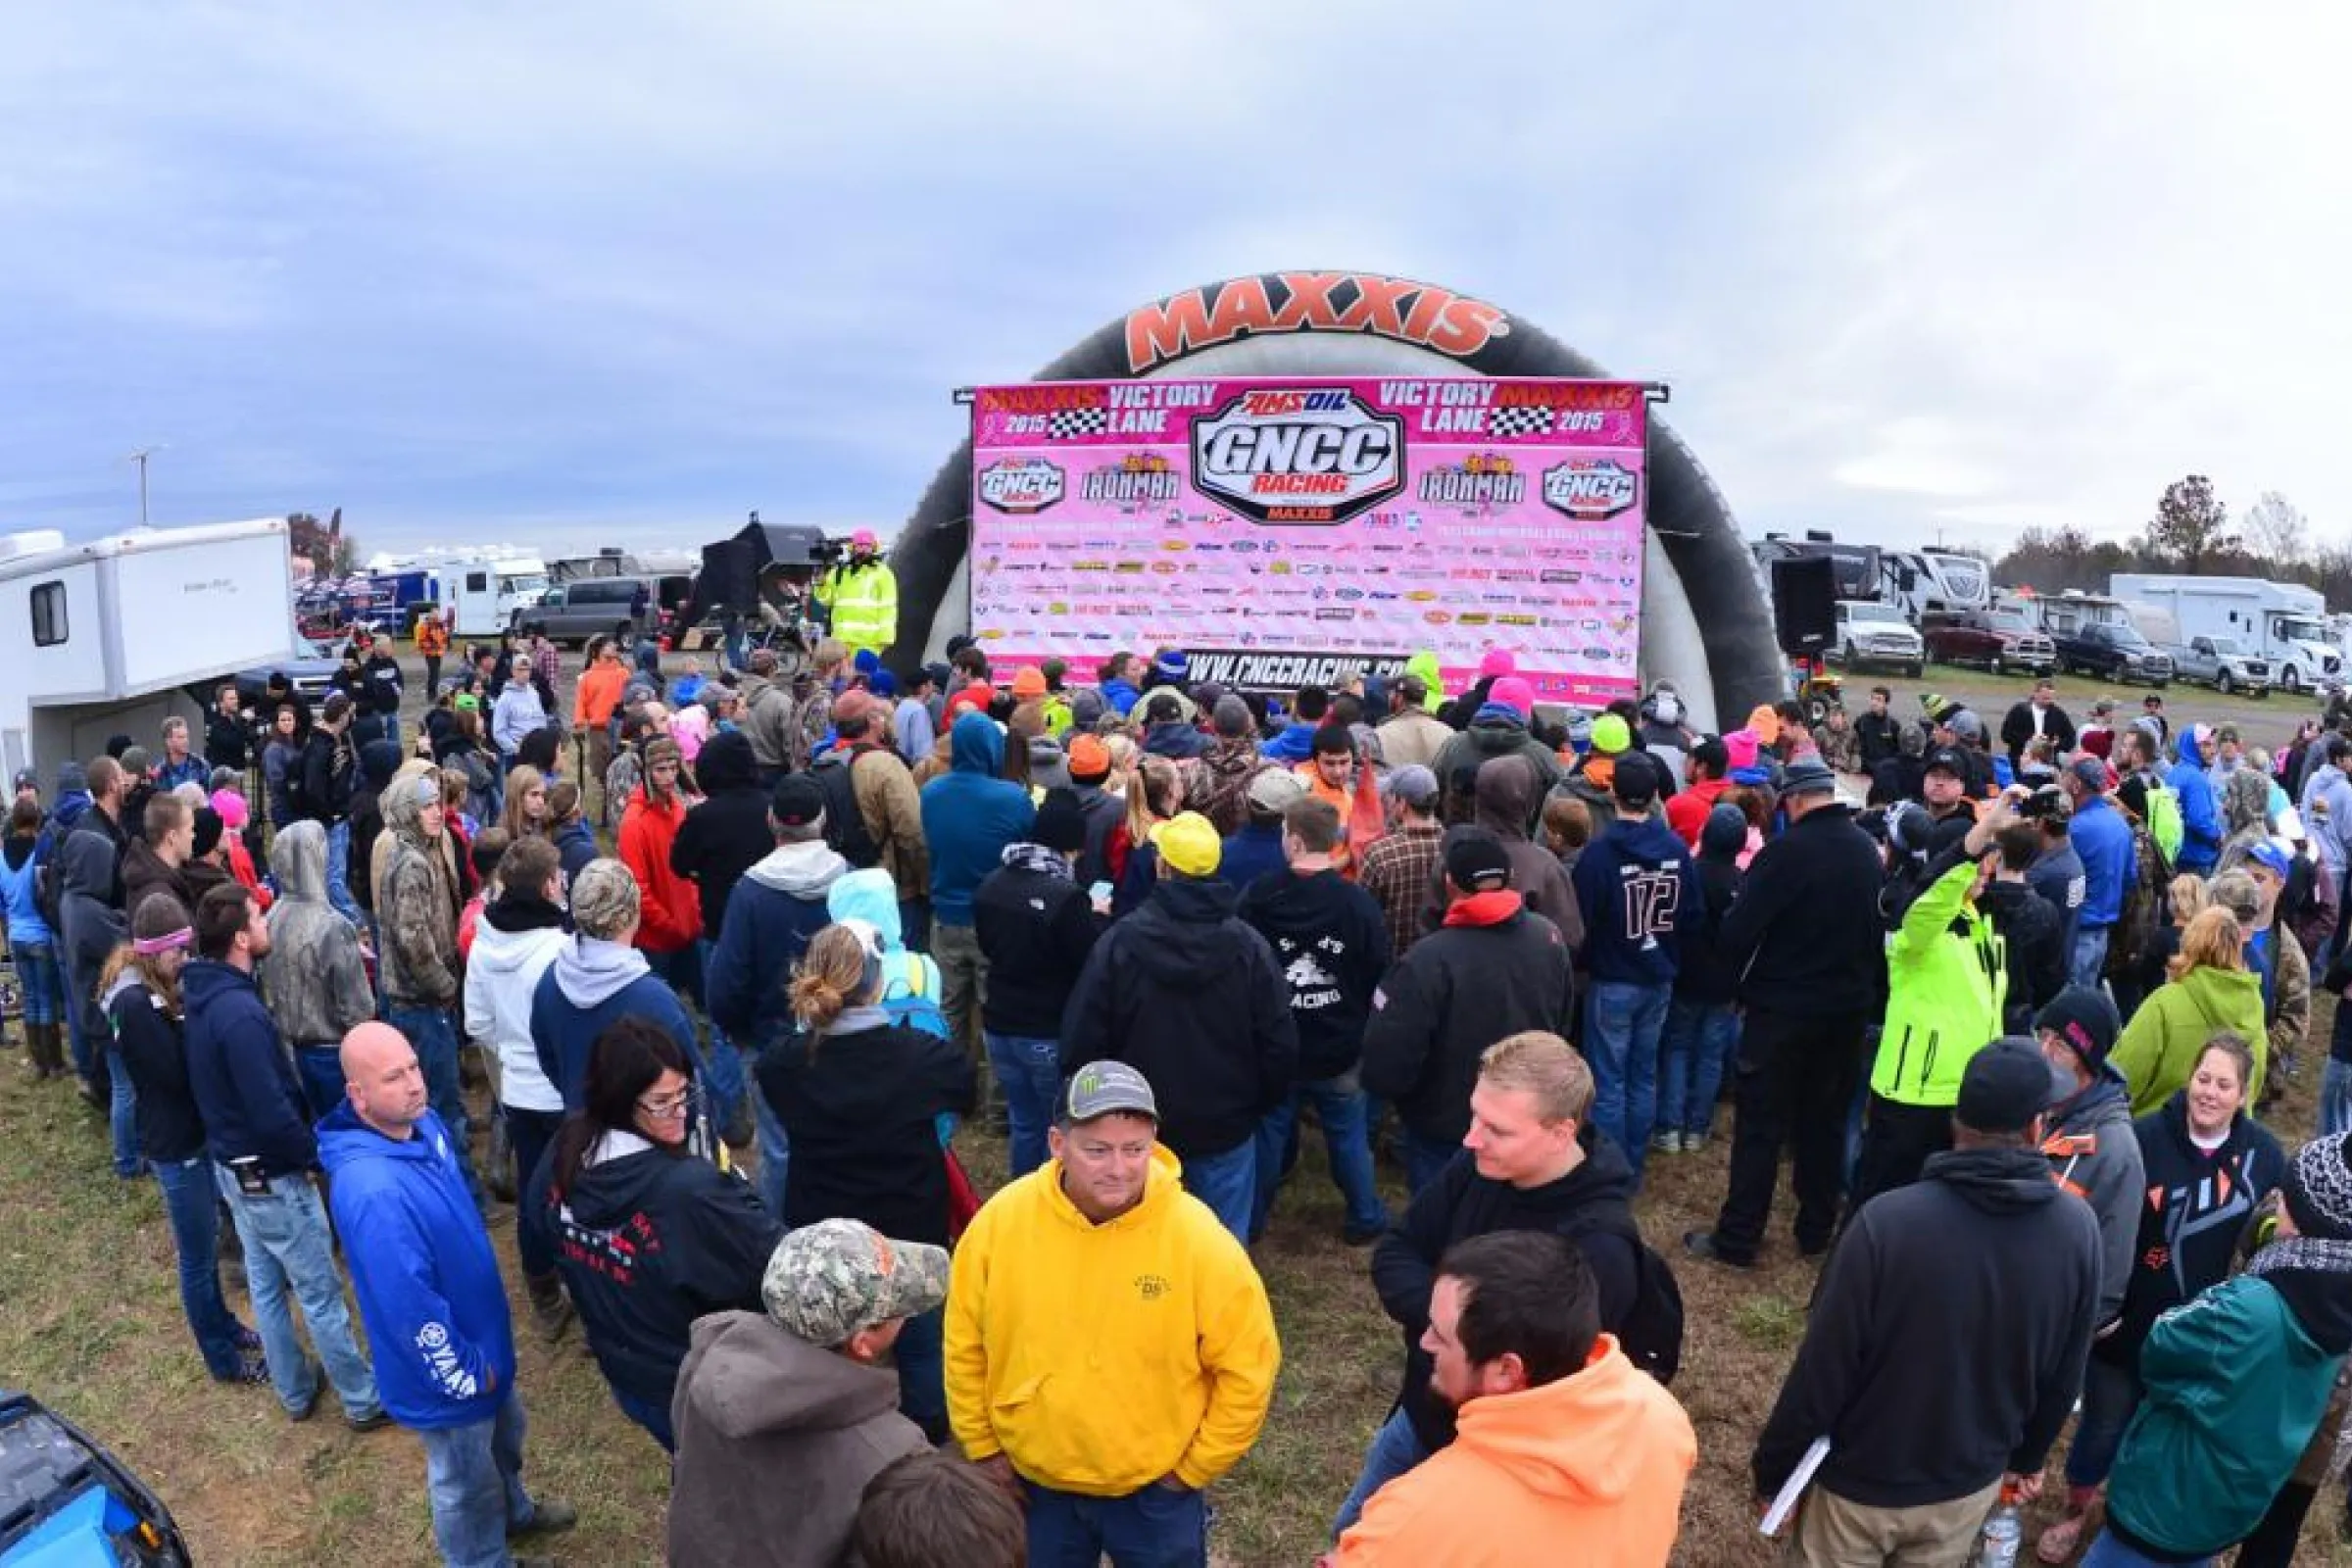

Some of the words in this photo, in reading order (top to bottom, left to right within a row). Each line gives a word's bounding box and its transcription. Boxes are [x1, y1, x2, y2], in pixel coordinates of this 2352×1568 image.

[1126, 270, 1501, 373] MAXXIS
[1109, 385, 1216, 407] VICTORY
[1244, 392, 1348, 416] AMSOIL
[1381, 380, 1497, 407] VICTORY
[1004, 414, 1048, 433] 2015
[1107, 410, 1169, 433] LANE
[1421, 407, 1489, 433] LANE
[1557, 412, 1604, 431] 2015
[1205, 424, 1391, 474] GNCC
[1252, 474, 1348, 494] RACING
